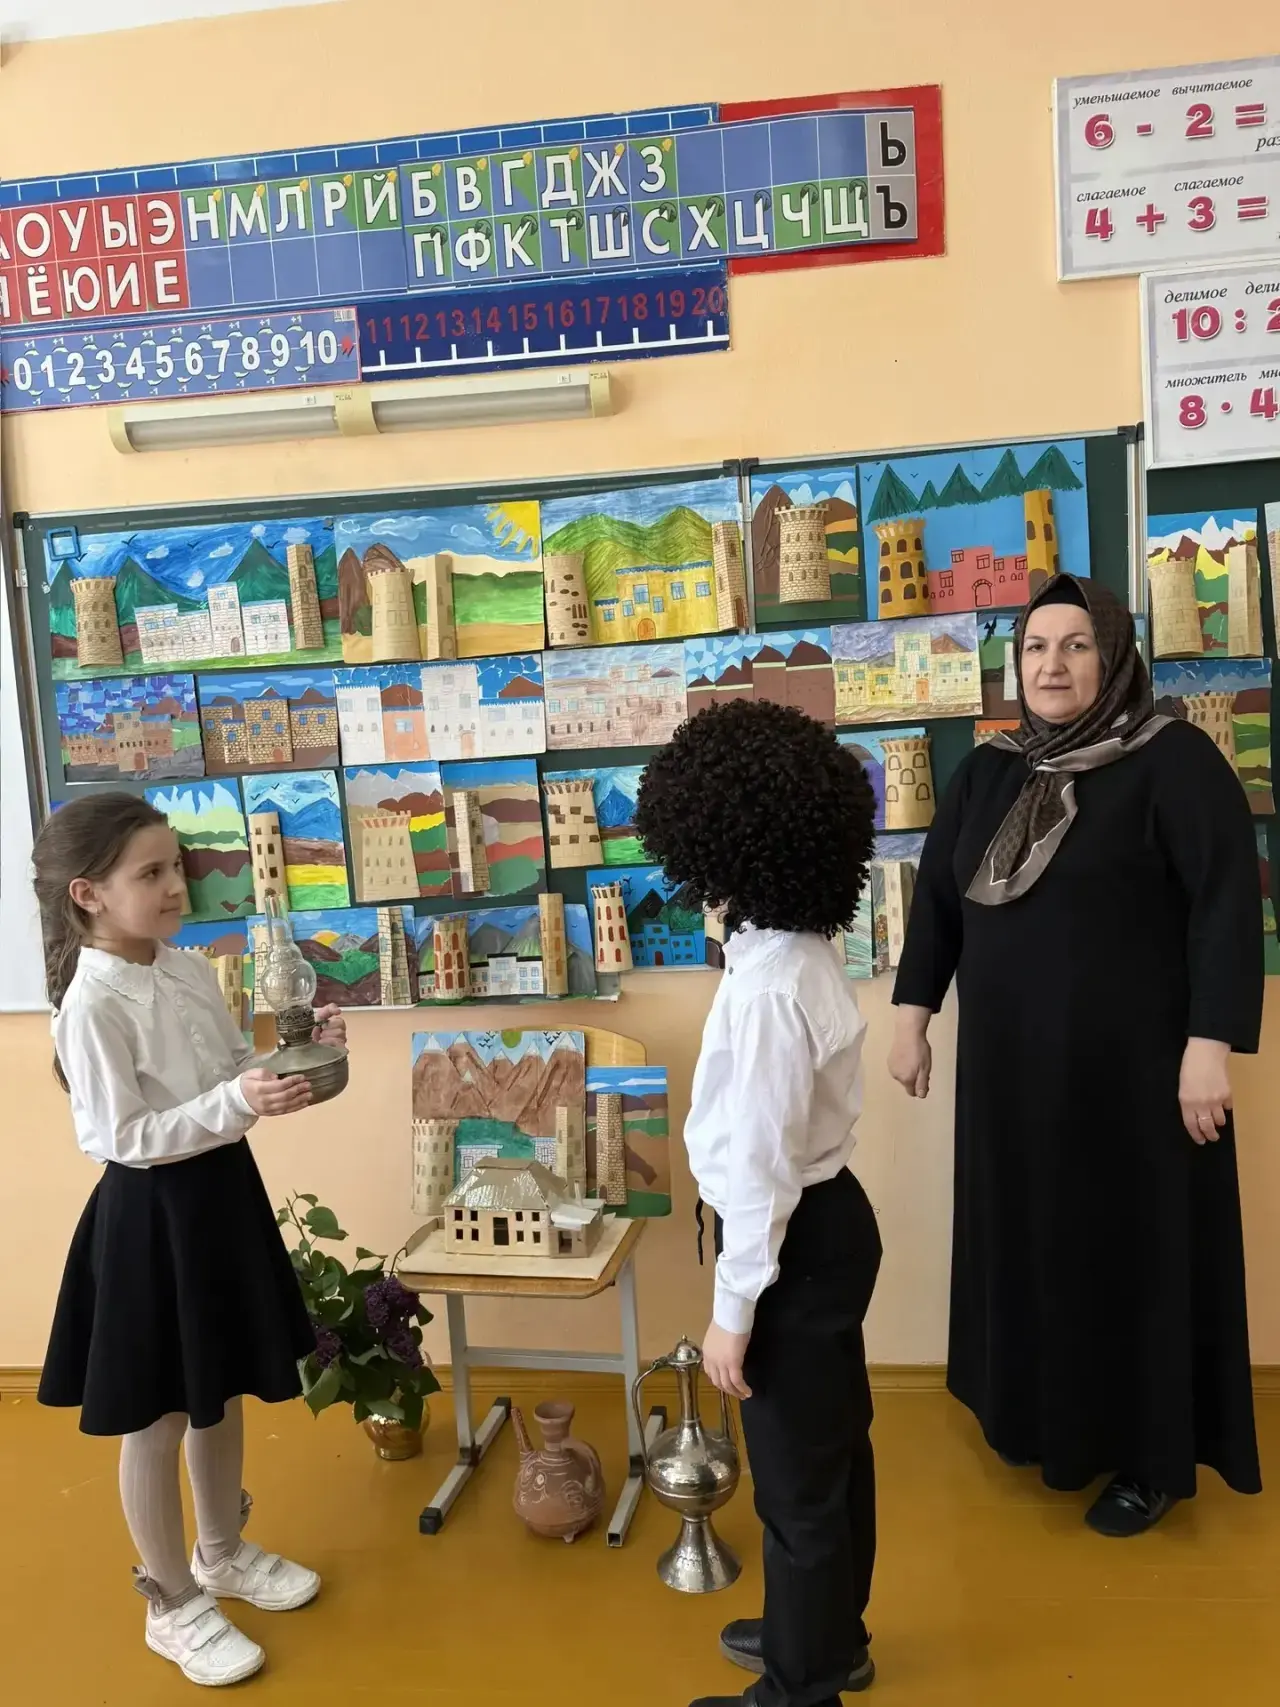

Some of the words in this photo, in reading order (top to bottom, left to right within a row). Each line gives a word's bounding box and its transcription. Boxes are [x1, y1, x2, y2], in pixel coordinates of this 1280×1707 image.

[1073, 87, 1160, 109] уменьшаемое
[1172, 78, 1253, 96] вычитаемое
[1084, 113, 1115, 149] 6
[1185, 103, 1215, 139] 2
[16, 212, 51, 258] О
[58, 206, 88, 252] У
[101, 202, 138, 249] Ы
[147, 199, 176, 245] Э
[187, 194, 220, 242] Н
[229, 190, 268, 238] М
[275, 185, 306, 233] Л
[322, 181, 347, 227] Р
[363, 173, 398, 224] Й
[411, 170, 437, 218] Б
[456, 166, 483, 212] В
[502, 159, 526, 206] Г
[541, 154, 578, 209] Д
[583, 150, 629, 198] Ж
[879, 121, 907, 167] Ь
[1076, 186, 1147, 203] слагаемое
[1174, 175, 1244, 192] слагаемое
[1085, 206, 1114, 241] 4
[1187, 196, 1216, 232] 3
[27, 265, 52, 316] Ё
[62, 266, 100, 313] Ю
[106, 262, 141, 309] И
[154, 259, 180, 304] Е
[413, 231, 445, 278] П
[454, 227, 491, 273] Ф
[503, 220, 535, 269] К
[550, 216, 577, 263] Т
[589, 211, 631, 261] Ш
[642, 207, 671, 255] С
[687, 203, 720, 251] Х
[734, 197, 769, 250] Ц
[781, 190, 811, 238] Ч
[823, 185, 869, 238] Щ
[876, 184, 908, 229] Ъ
[366, 316, 393, 344] 11
[400, 313, 430, 341] 12
[435, 309, 465, 338] 13
[472, 306, 502, 334] 14
[508, 303, 538, 332] 15
[544, 299, 575, 329] 16
[580, 296, 610, 325] 17
[618, 293, 648, 321] 18
[656, 289, 685, 318] 19
[692, 286, 723, 316] 20
[1164, 287, 1228, 303] делимое
[24, 340, 35, 348] +1
[53, 337, 64, 345] +1
[82, 334, 94, 343] +1
[113, 332, 124, 340] +1
[142, 330, 153, 338] +1
[171, 327, 182, 335] +1
[201, 324, 212, 332] +1
[229, 321, 240, 329] +1
[259, 318, 271, 326] +1
[291, 315, 302, 323] +1
[1172, 304, 1222, 342] 10
[13, 357, 33, 391] 0
[41, 354, 55, 388] 1
[67, 352, 86, 386] 2
[95, 349, 116, 383] 3
[125, 347, 146, 380] 4
[156, 345, 174, 379] 5
[185, 341, 204, 376] 6
[212, 340, 230, 373] 7
[241, 336, 261, 370] 8
[270, 333, 290, 368] 9
[300, 329, 338, 365] 10
[1165, 371, 1247, 388] множитель
[1259, 369, 1280, 379] мн
[1179, 395, 1207, 429] 8
[1249, 386, 1279, 419] 4
